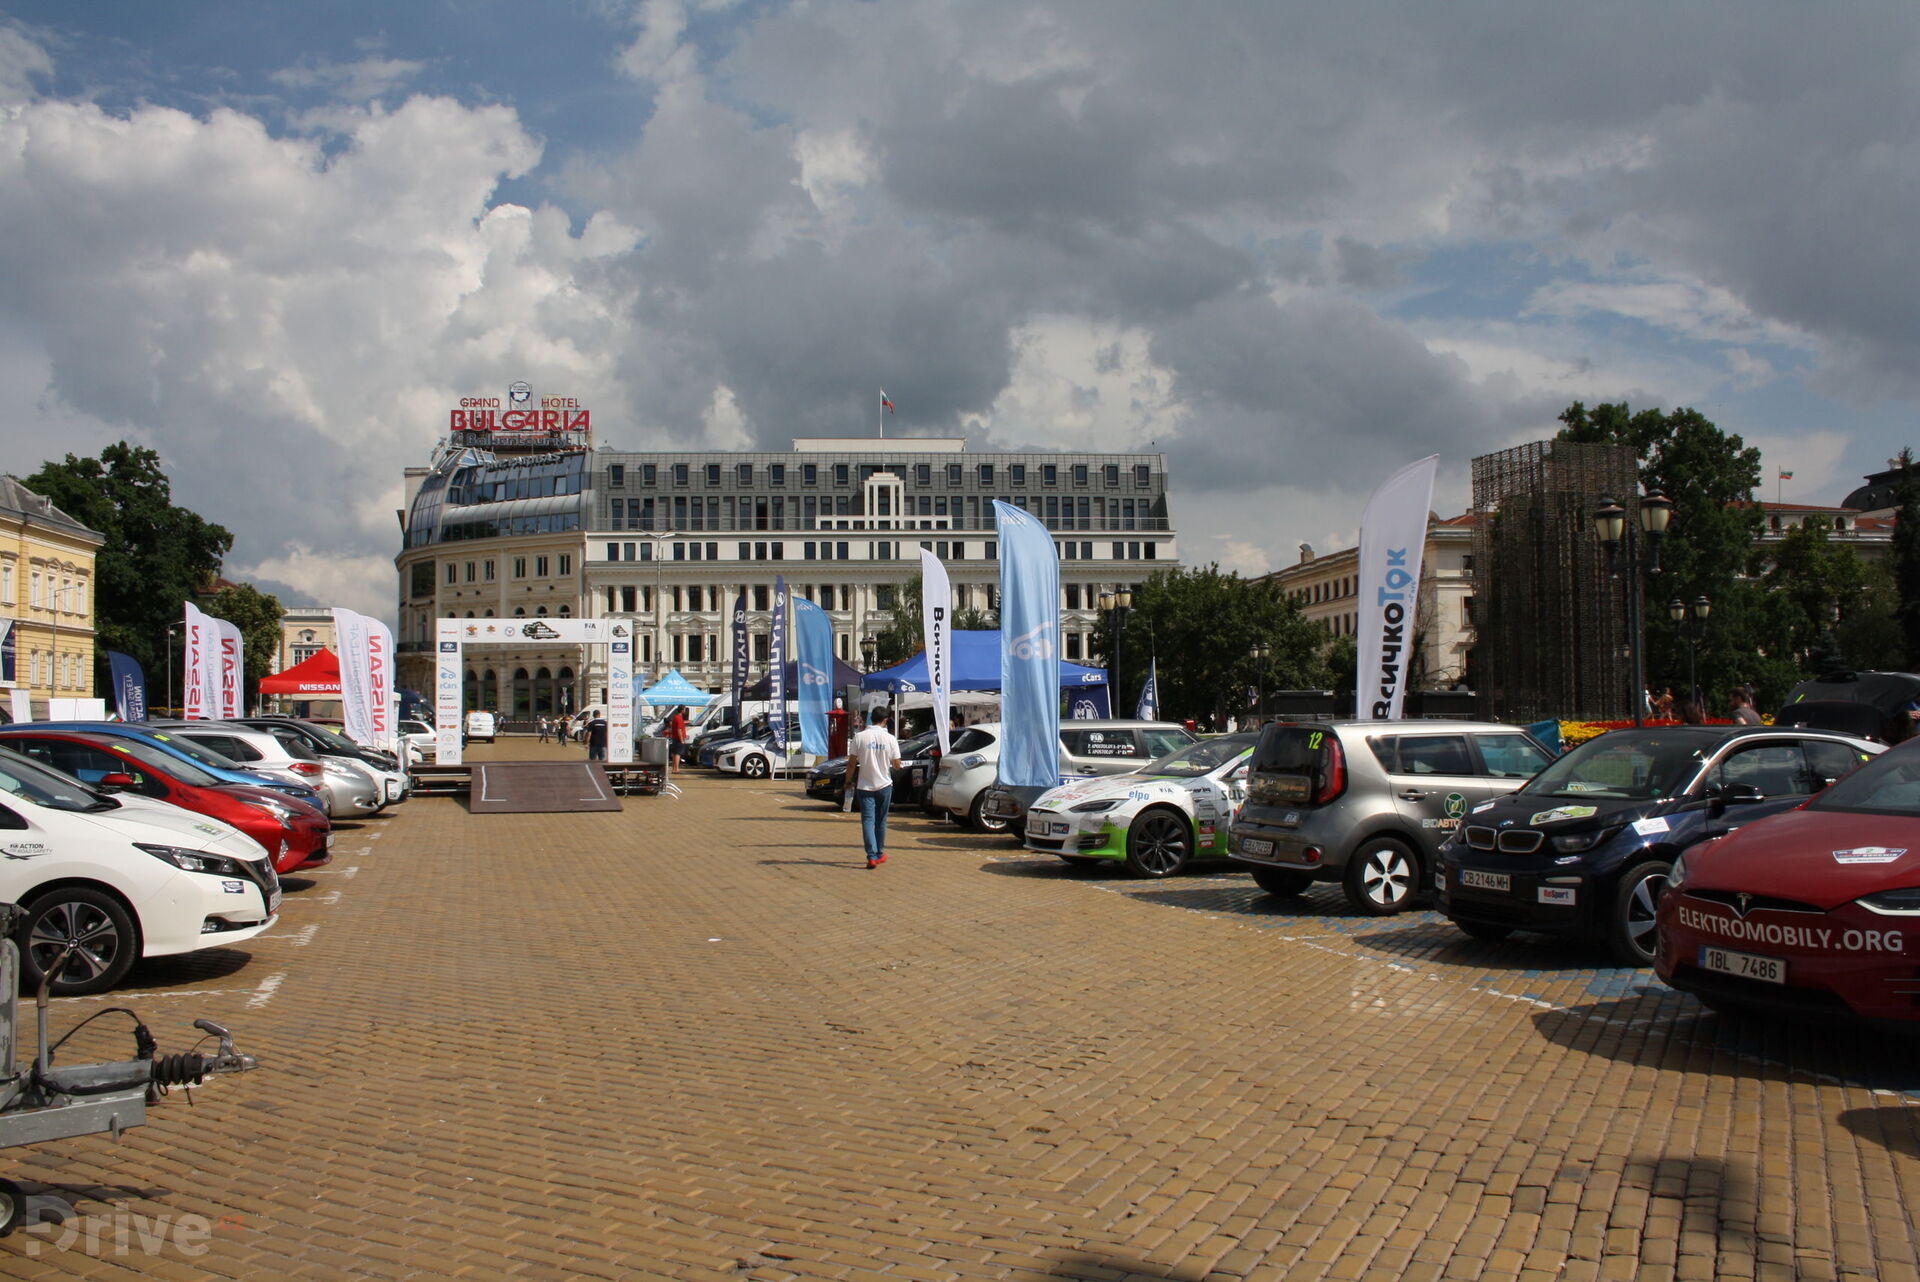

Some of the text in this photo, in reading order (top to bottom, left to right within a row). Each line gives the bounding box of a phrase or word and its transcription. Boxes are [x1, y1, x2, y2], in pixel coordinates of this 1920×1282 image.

[460, 398, 580, 408] GRAND HOTEL
[450, 410, 590, 431] BULGARIA
[1081, 673, 1102, 682] eCars
[1308, 732, 1323, 750] 12
[1128, 790, 1150, 801] elpo
[1463, 872, 1509, 889] CB 2146 MH
[1679, 906, 1903, 951] ELEKTROMOBILY.ORG
[1708, 950, 1777, 980] 1BL 7486
